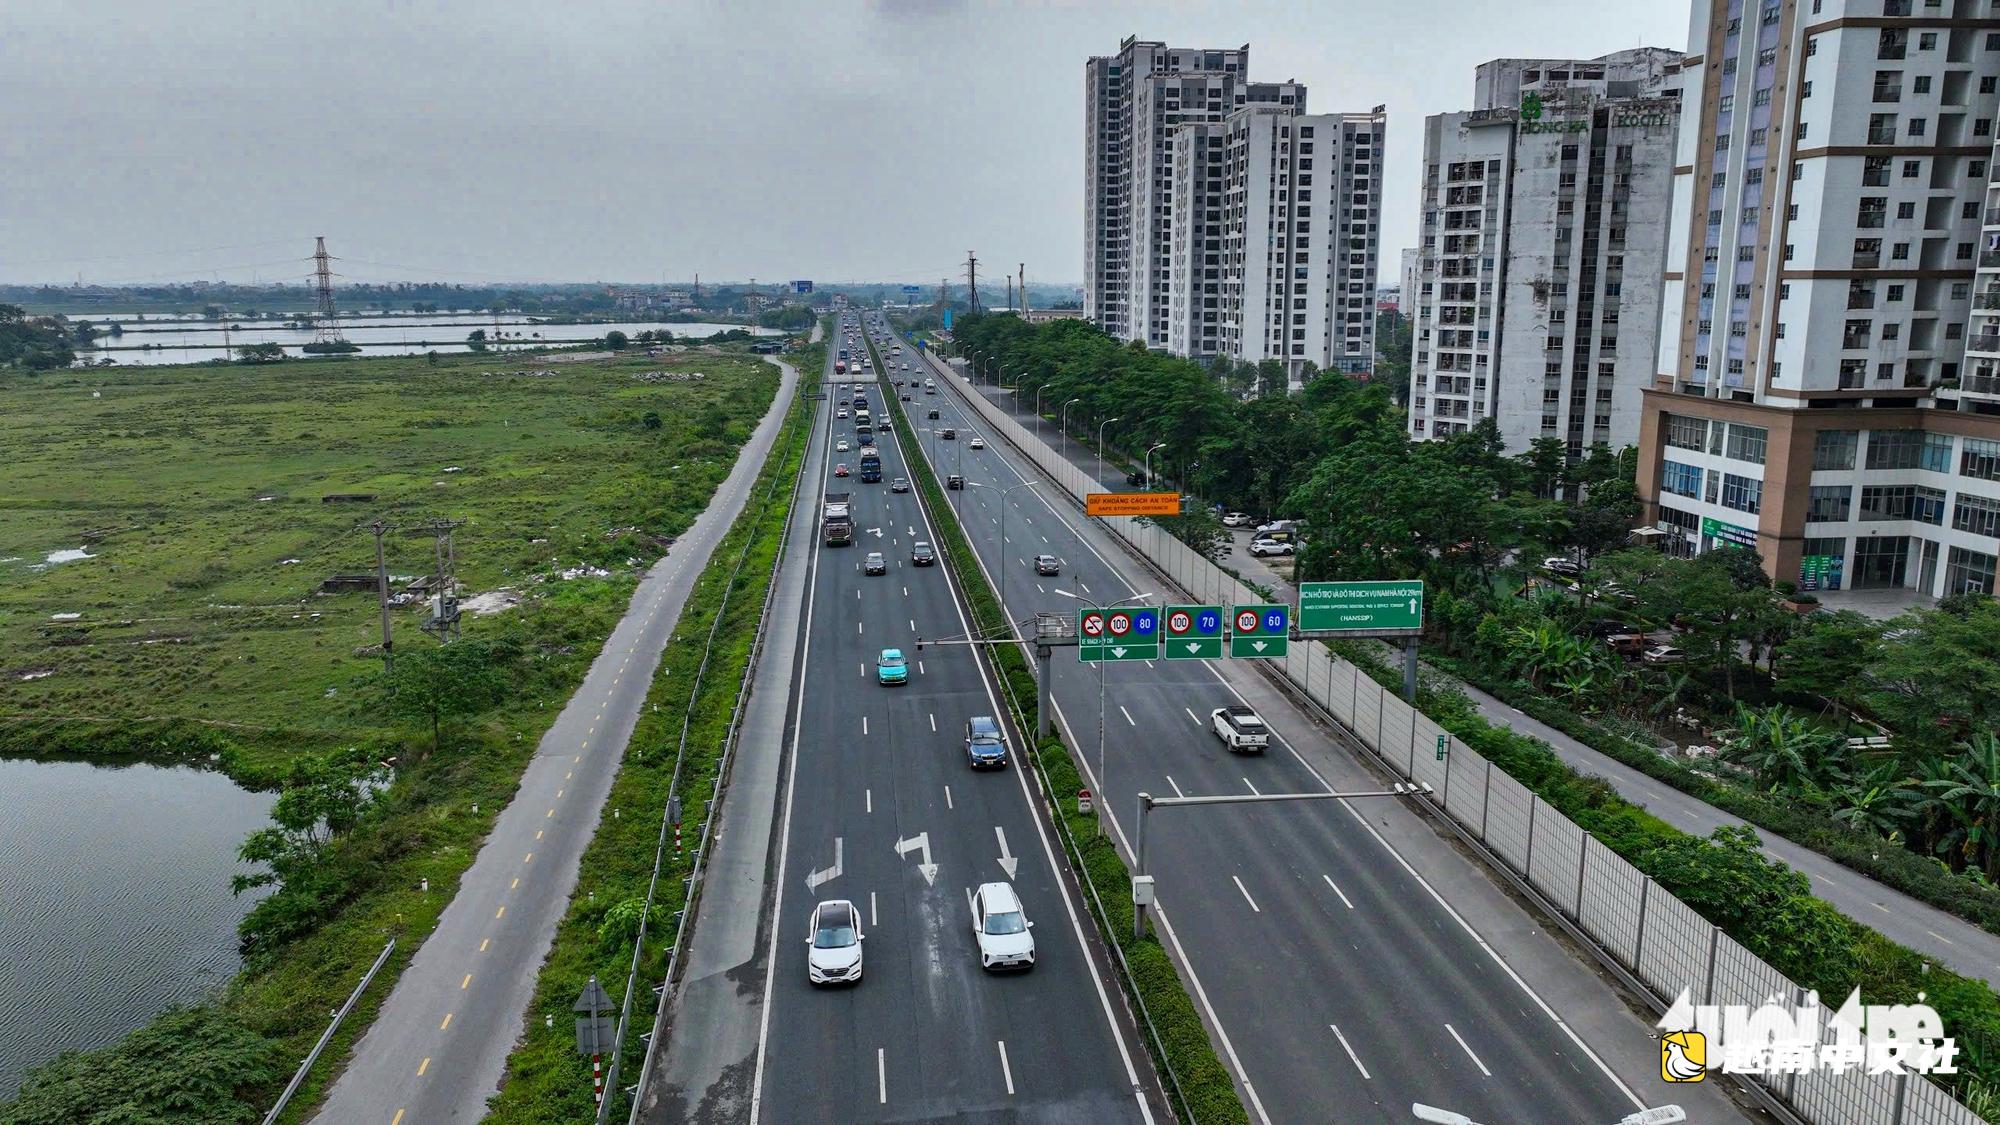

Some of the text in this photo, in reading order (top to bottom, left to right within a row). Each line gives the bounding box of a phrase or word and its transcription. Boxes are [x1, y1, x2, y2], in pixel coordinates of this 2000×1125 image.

[1113, 619, 1126, 630] 100
[1139, 618, 1151, 629] 80
[1173, 618, 1186, 628] 100
[1202, 617, 1214, 627] 70
[1241, 617, 1254, 627] 100
[1268, 616, 1281, 626] 60
